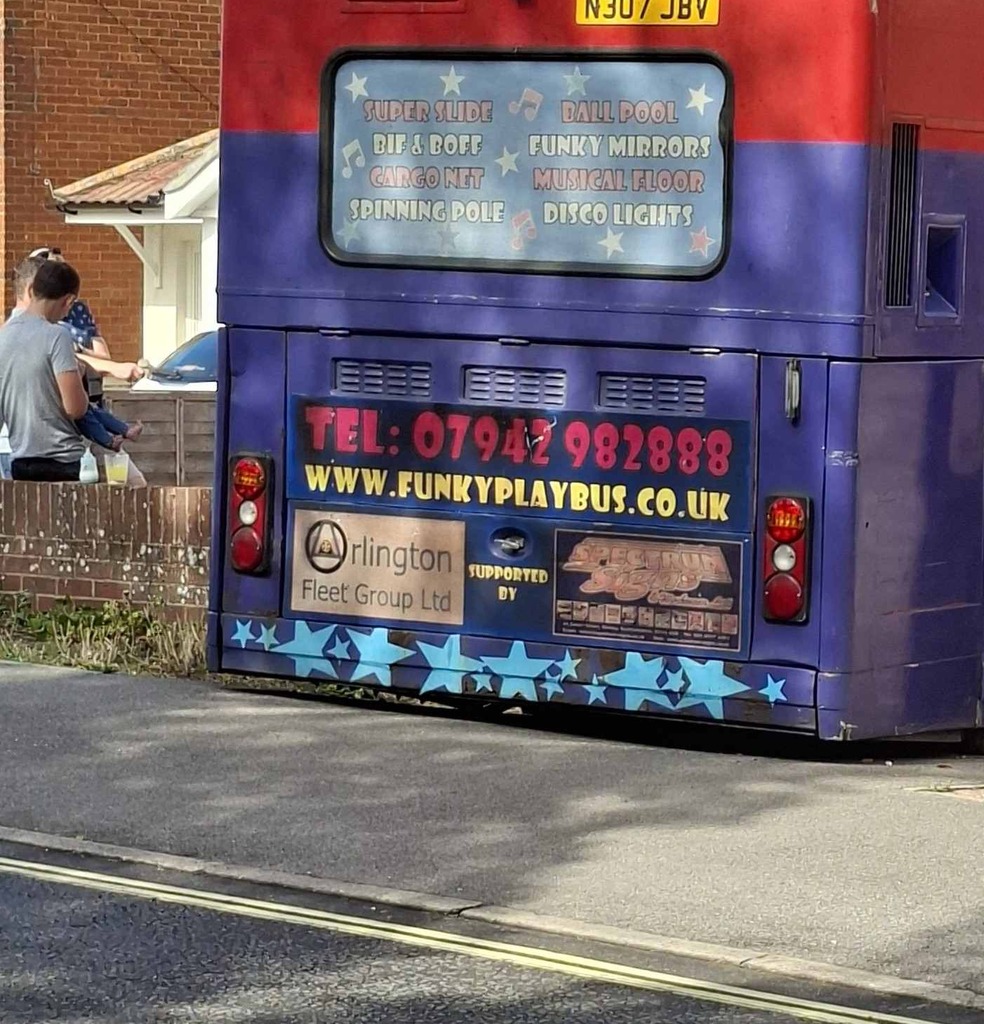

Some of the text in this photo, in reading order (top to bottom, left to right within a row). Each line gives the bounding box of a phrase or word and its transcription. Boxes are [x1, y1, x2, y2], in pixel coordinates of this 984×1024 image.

[363, 98, 493, 123] SUPER SLIDE
[561, 100, 679, 124] BALL POOL
[372, 132, 484, 156] BIF & BOFF
[528, 134, 711, 159] FUNKY MIRRORS
[370, 165, 485, 190] CARGO NET
[533, 168, 705, 193] MUSICAL FLOOR
[349, 198, 505, 223] SPINNING POLE
[543, 201, 694, 227] DISCO LIGHTS
[304, 405, 732, 476] TEL: 07942 982888
[304, 464, 731, 522] WWW.FUNKYPLAYBUS.CO.UK
[468, 563, 549, 584] SUPPORTED
[302, 579, 451, 613] Fleet Group Ltd
[498, 586, 518, 601] BY
